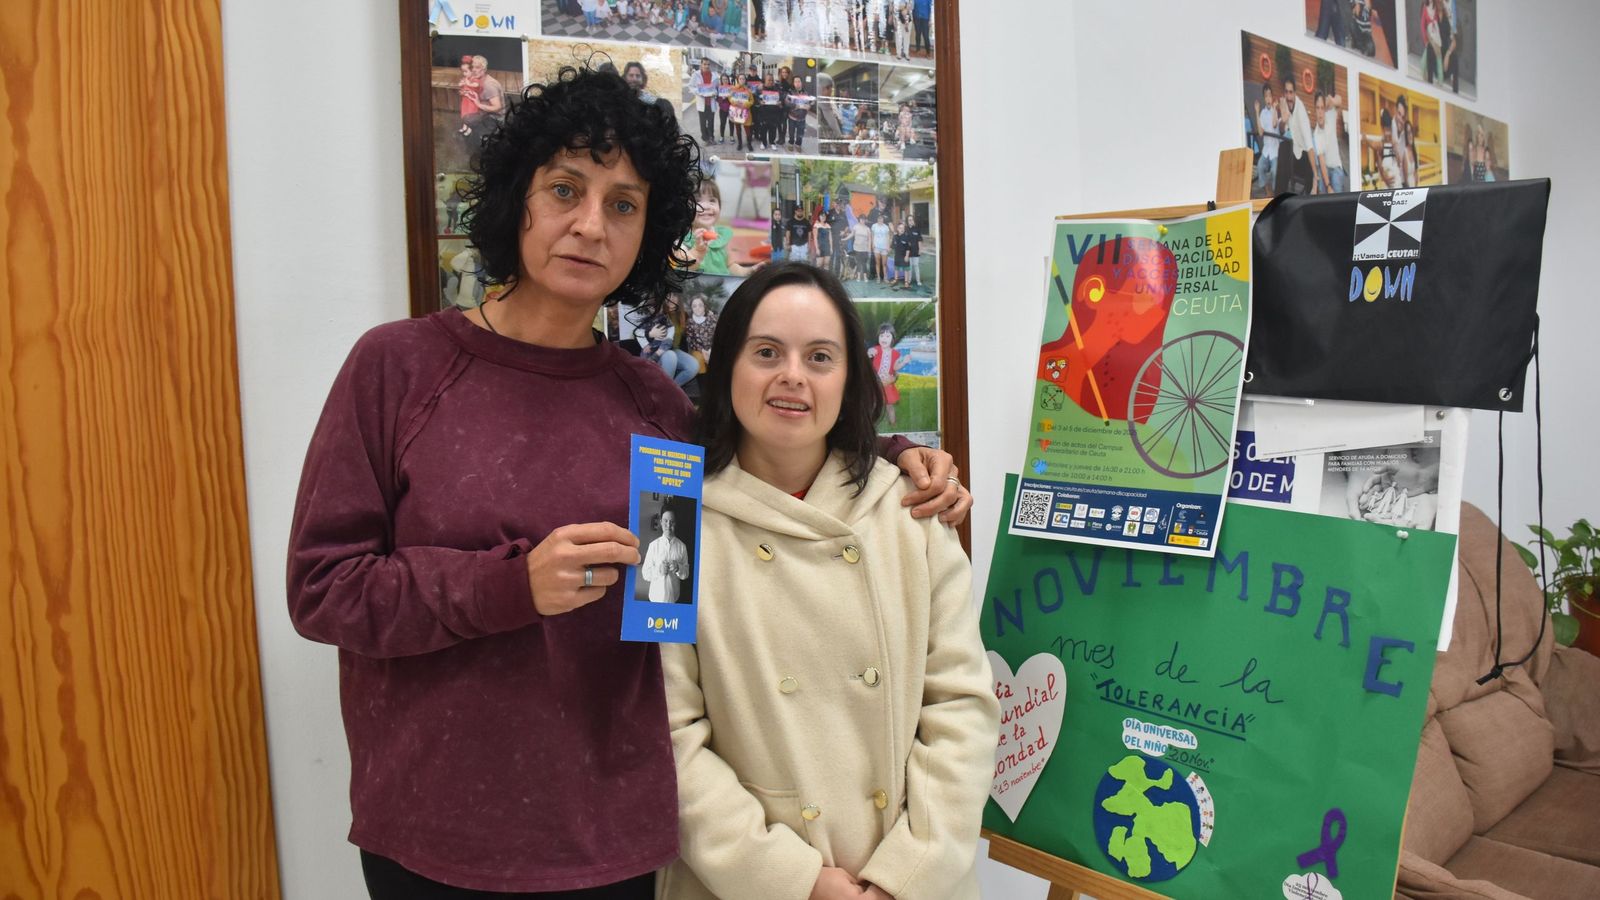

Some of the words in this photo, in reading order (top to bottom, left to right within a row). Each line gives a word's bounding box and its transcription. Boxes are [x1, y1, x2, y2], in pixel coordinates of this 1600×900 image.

[464, 14, 514, 30] DOWN
[1066, 234, 1122, 265] VII
[1128, 239, 1190, 250] SEMANA
[1194, 234, 1212, 248] DE
[1217, 230, 1232, 244] LA
[1123, 246, 1234, 264] DISCAPACIDAD
[1388, 250, 1418, 258] CEUTA!!
[1124, 262, 1240, 280] ACCESIBILIDAD
[1135, 280, 1219, 294] UNIVERSAL
[1349, 262, 1416, 302] DOWN
[1173, 294, 1242, 316] CEUTA
[1248, 472, 1276, 492] DE
[648, 617, 678, 630] DOWN
[993, 548, 1414, 698] NOVIEMBRE
[1052, 636, 1114, 669] mes
[1155, 641, 1198, 683] de
[1220, 658, 1284, 703] la
[995, 681, 1014, 700] ía
[1001, 673, 1058, 724] undial
[1013, 723, 1026, 741] la
[1126, 718, 1141, 732] DÍA
[1144, 724, 1196, 746] UNIVERSAL
[1125, 734, 1142, 748] DEL
[1144, 740, 1168, 754] NIÑO
